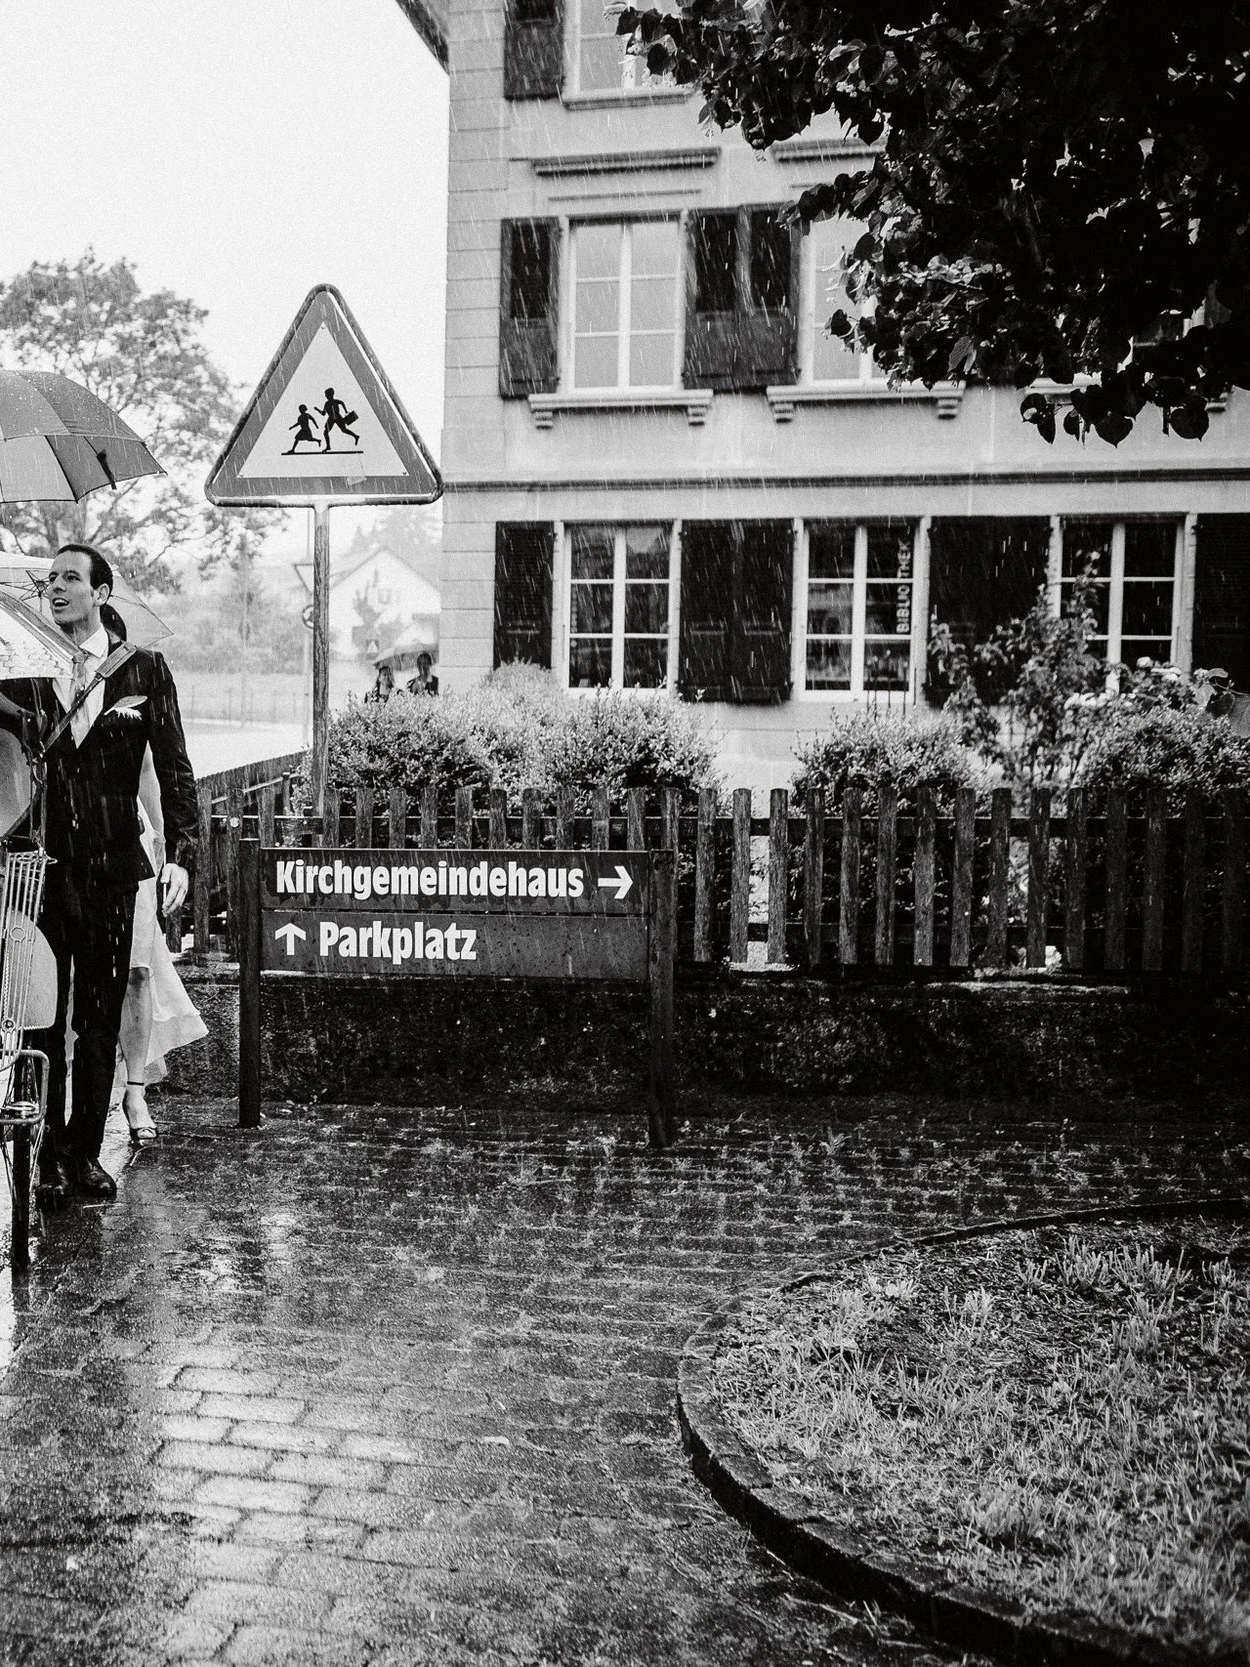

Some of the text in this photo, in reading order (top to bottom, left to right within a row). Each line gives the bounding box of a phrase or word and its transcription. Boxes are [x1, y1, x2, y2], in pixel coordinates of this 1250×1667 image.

[896, 538, 911, 633] BIBLIOTHEK
[276, 860, 584, 900] Kirchgemeindehaus
[319, 921, 477, 965] Parkplatz
